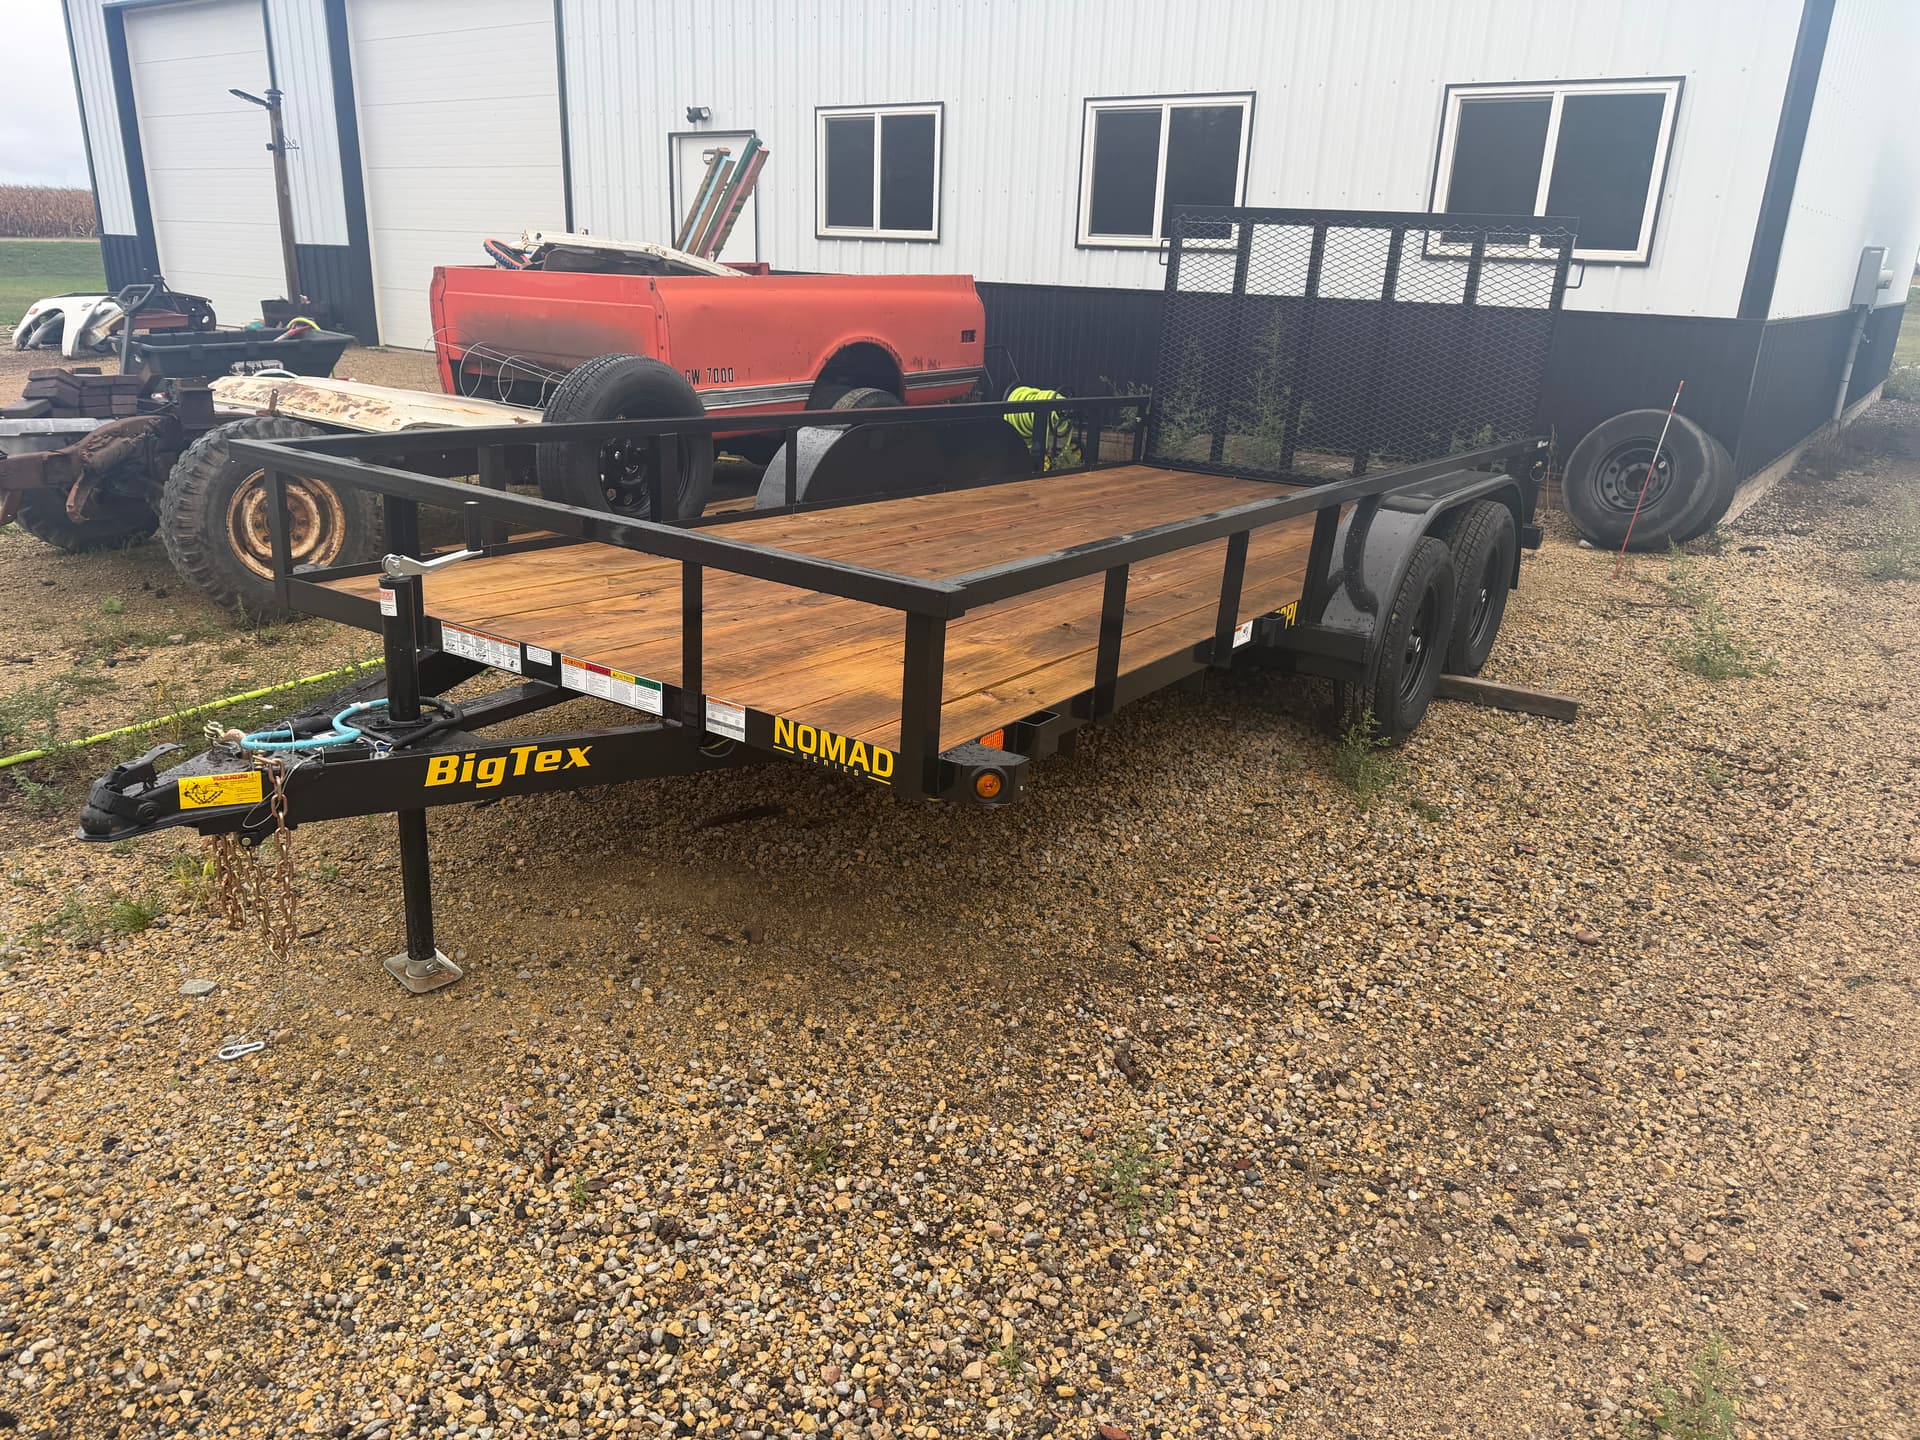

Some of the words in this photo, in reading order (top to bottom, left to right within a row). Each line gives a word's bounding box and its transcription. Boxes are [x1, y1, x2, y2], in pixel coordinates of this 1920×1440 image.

[706, 367, 734, 383] 7000
[774, 716, 894, 778] NOMAD
[802, 752, 859, 776] SERIES
[424, 745, 593, 789] BigTex
